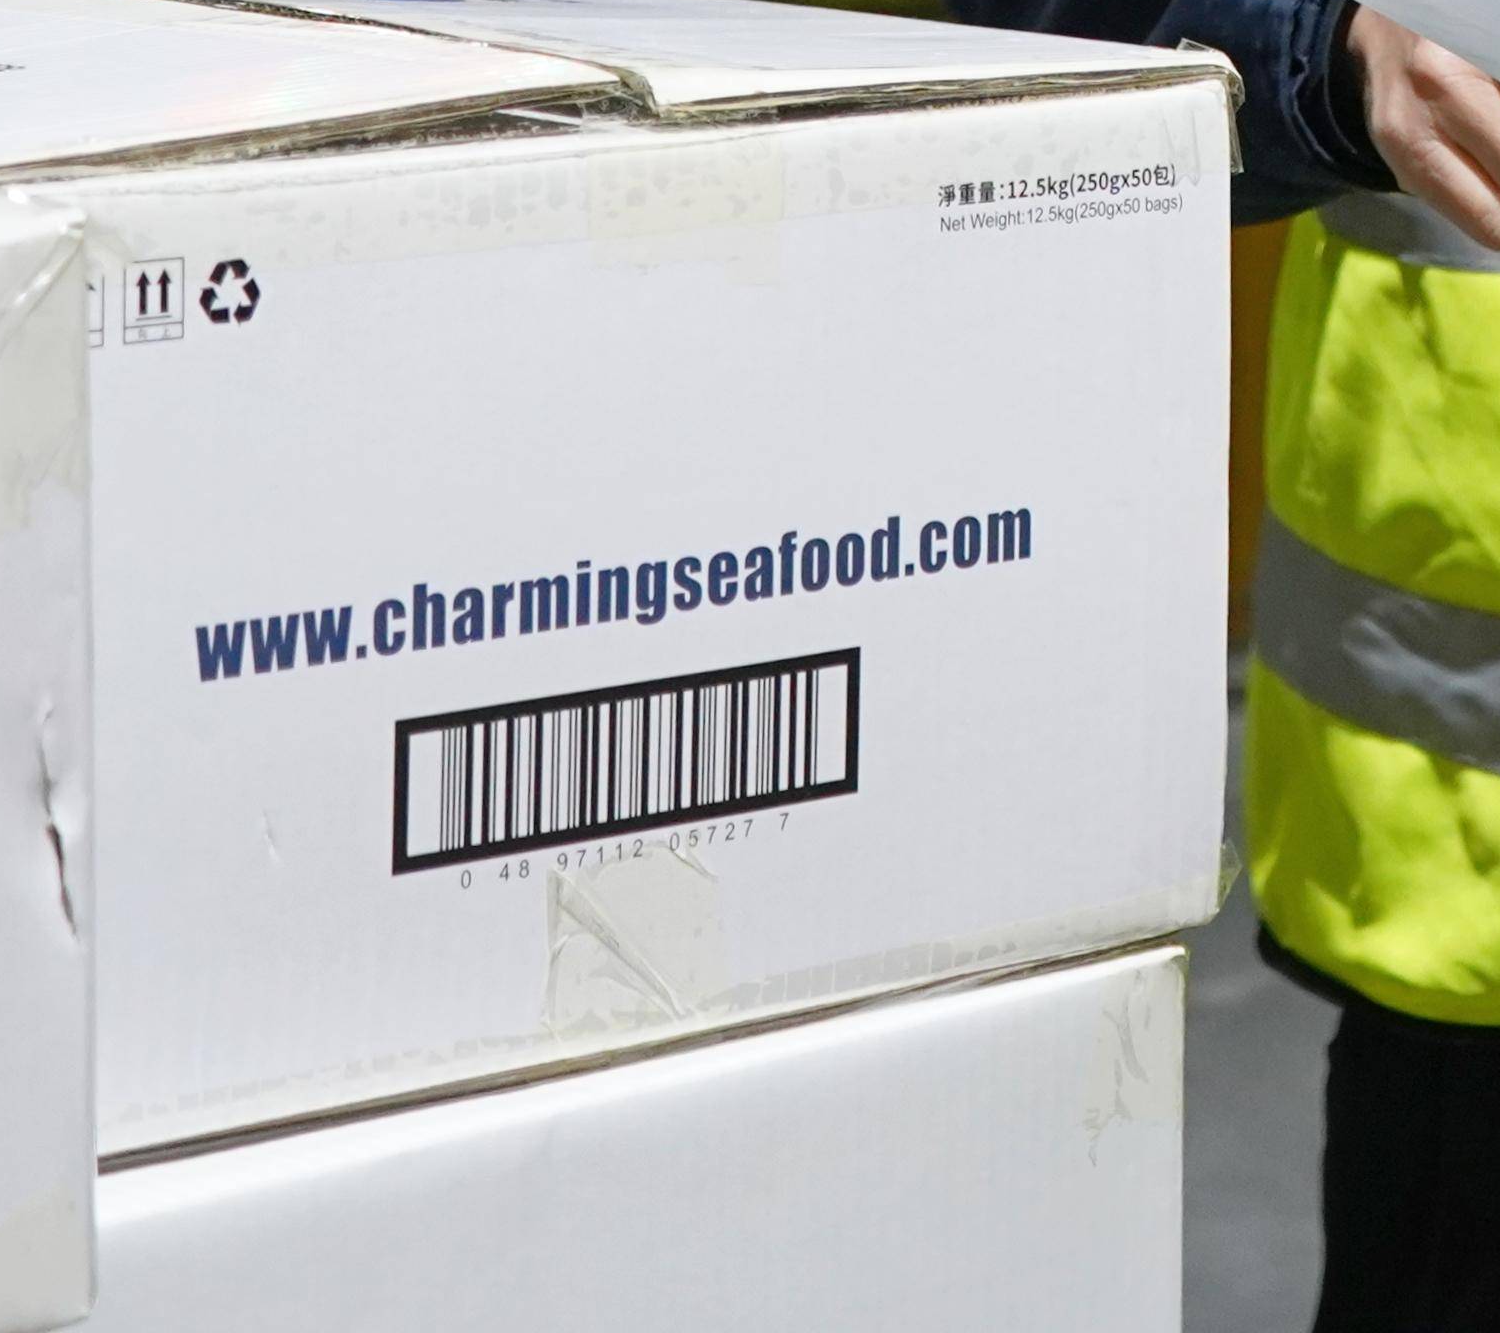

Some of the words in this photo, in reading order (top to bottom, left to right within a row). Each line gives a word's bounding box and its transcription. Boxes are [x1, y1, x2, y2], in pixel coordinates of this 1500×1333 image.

[937, 164, 1177, 209] 淨重量:12.5kg(250gx50包)
[939, 215, 966, 233] Net
[970, 199, 1141, 232] Weight:12.5kg(250gx50
[1144, 194, 1184, 215] bags)
[194, 506, 1034, 683] www.charmingseafood.com
[556, 838, 644, 872] 97112
[668, 818, 754, 853] 05727
[778, 812, 791, 832] 7
